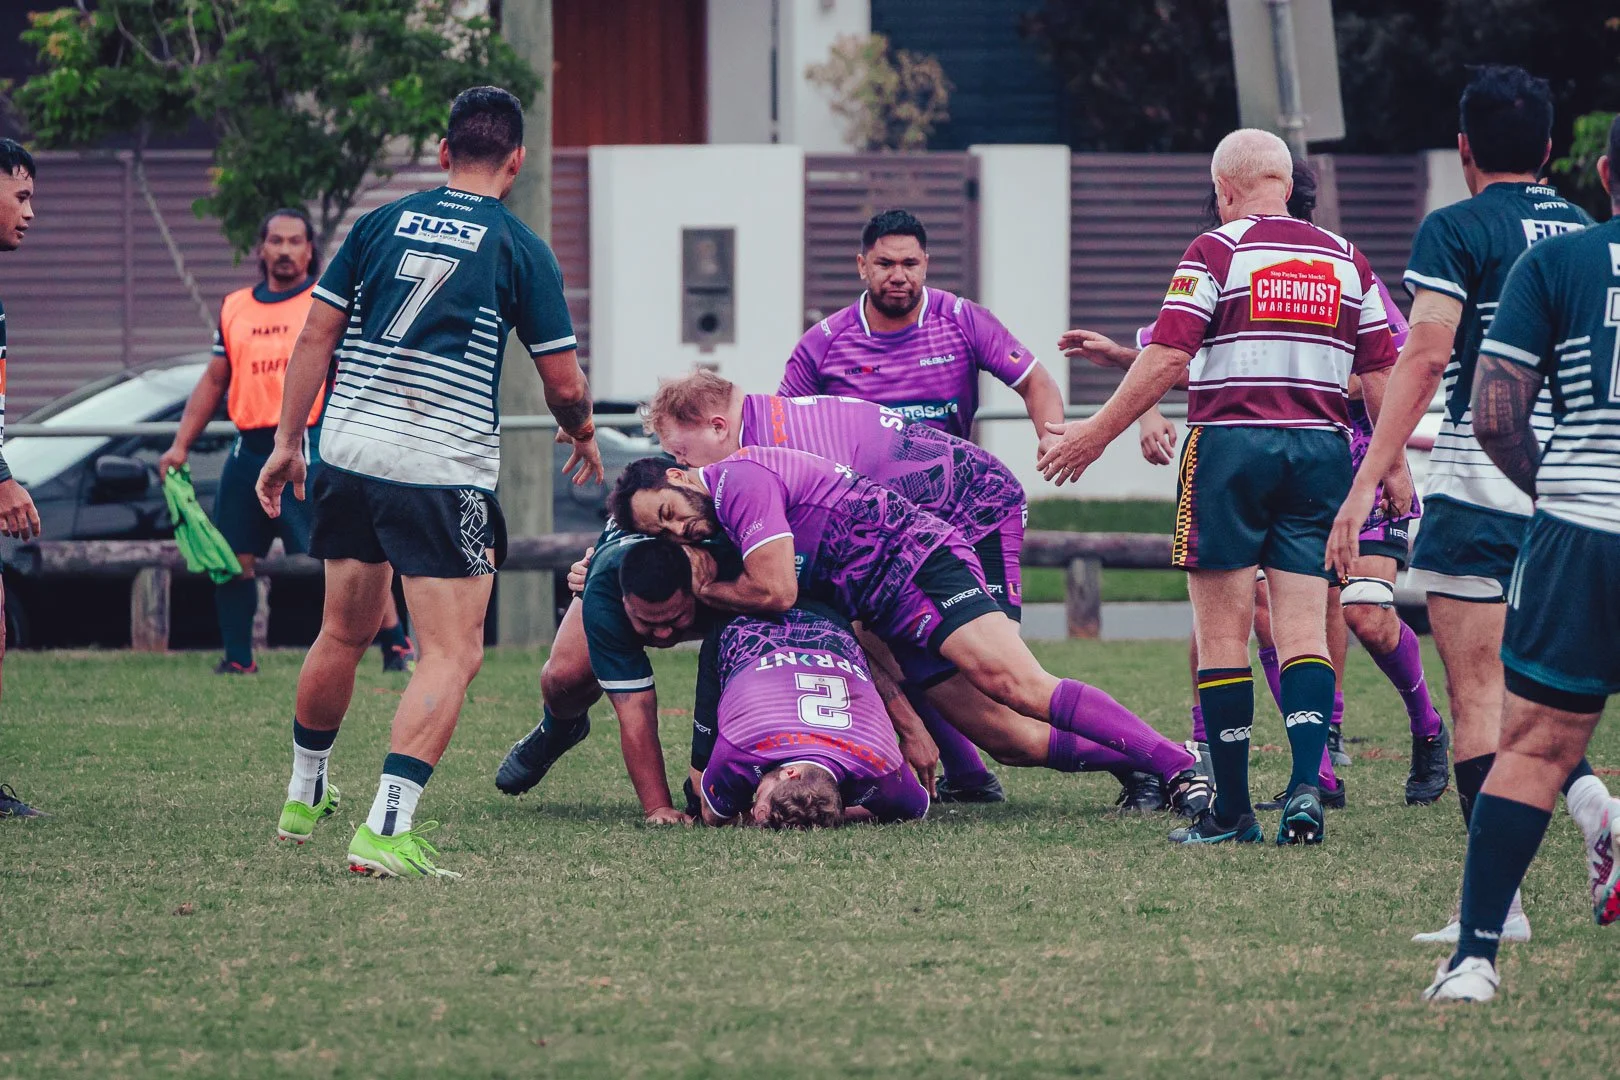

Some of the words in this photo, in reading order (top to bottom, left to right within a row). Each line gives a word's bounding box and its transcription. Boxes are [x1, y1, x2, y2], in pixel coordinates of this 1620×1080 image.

[444, 190, 483, 203] MATAI
[1526, 186, 1556, 197] MATAI
[437, 200, 474, 212] MATAI
[381, 249, 460, 342] 7
[1257, 278, 1338, 304] CHEMIST
[1257, 301, 1333, 317] WAREHOUSE
[919, 354, 956, 367] REBELS
[941, 587, 983, 609] INTERCEPT
[794, 672, 853, 730] 2
